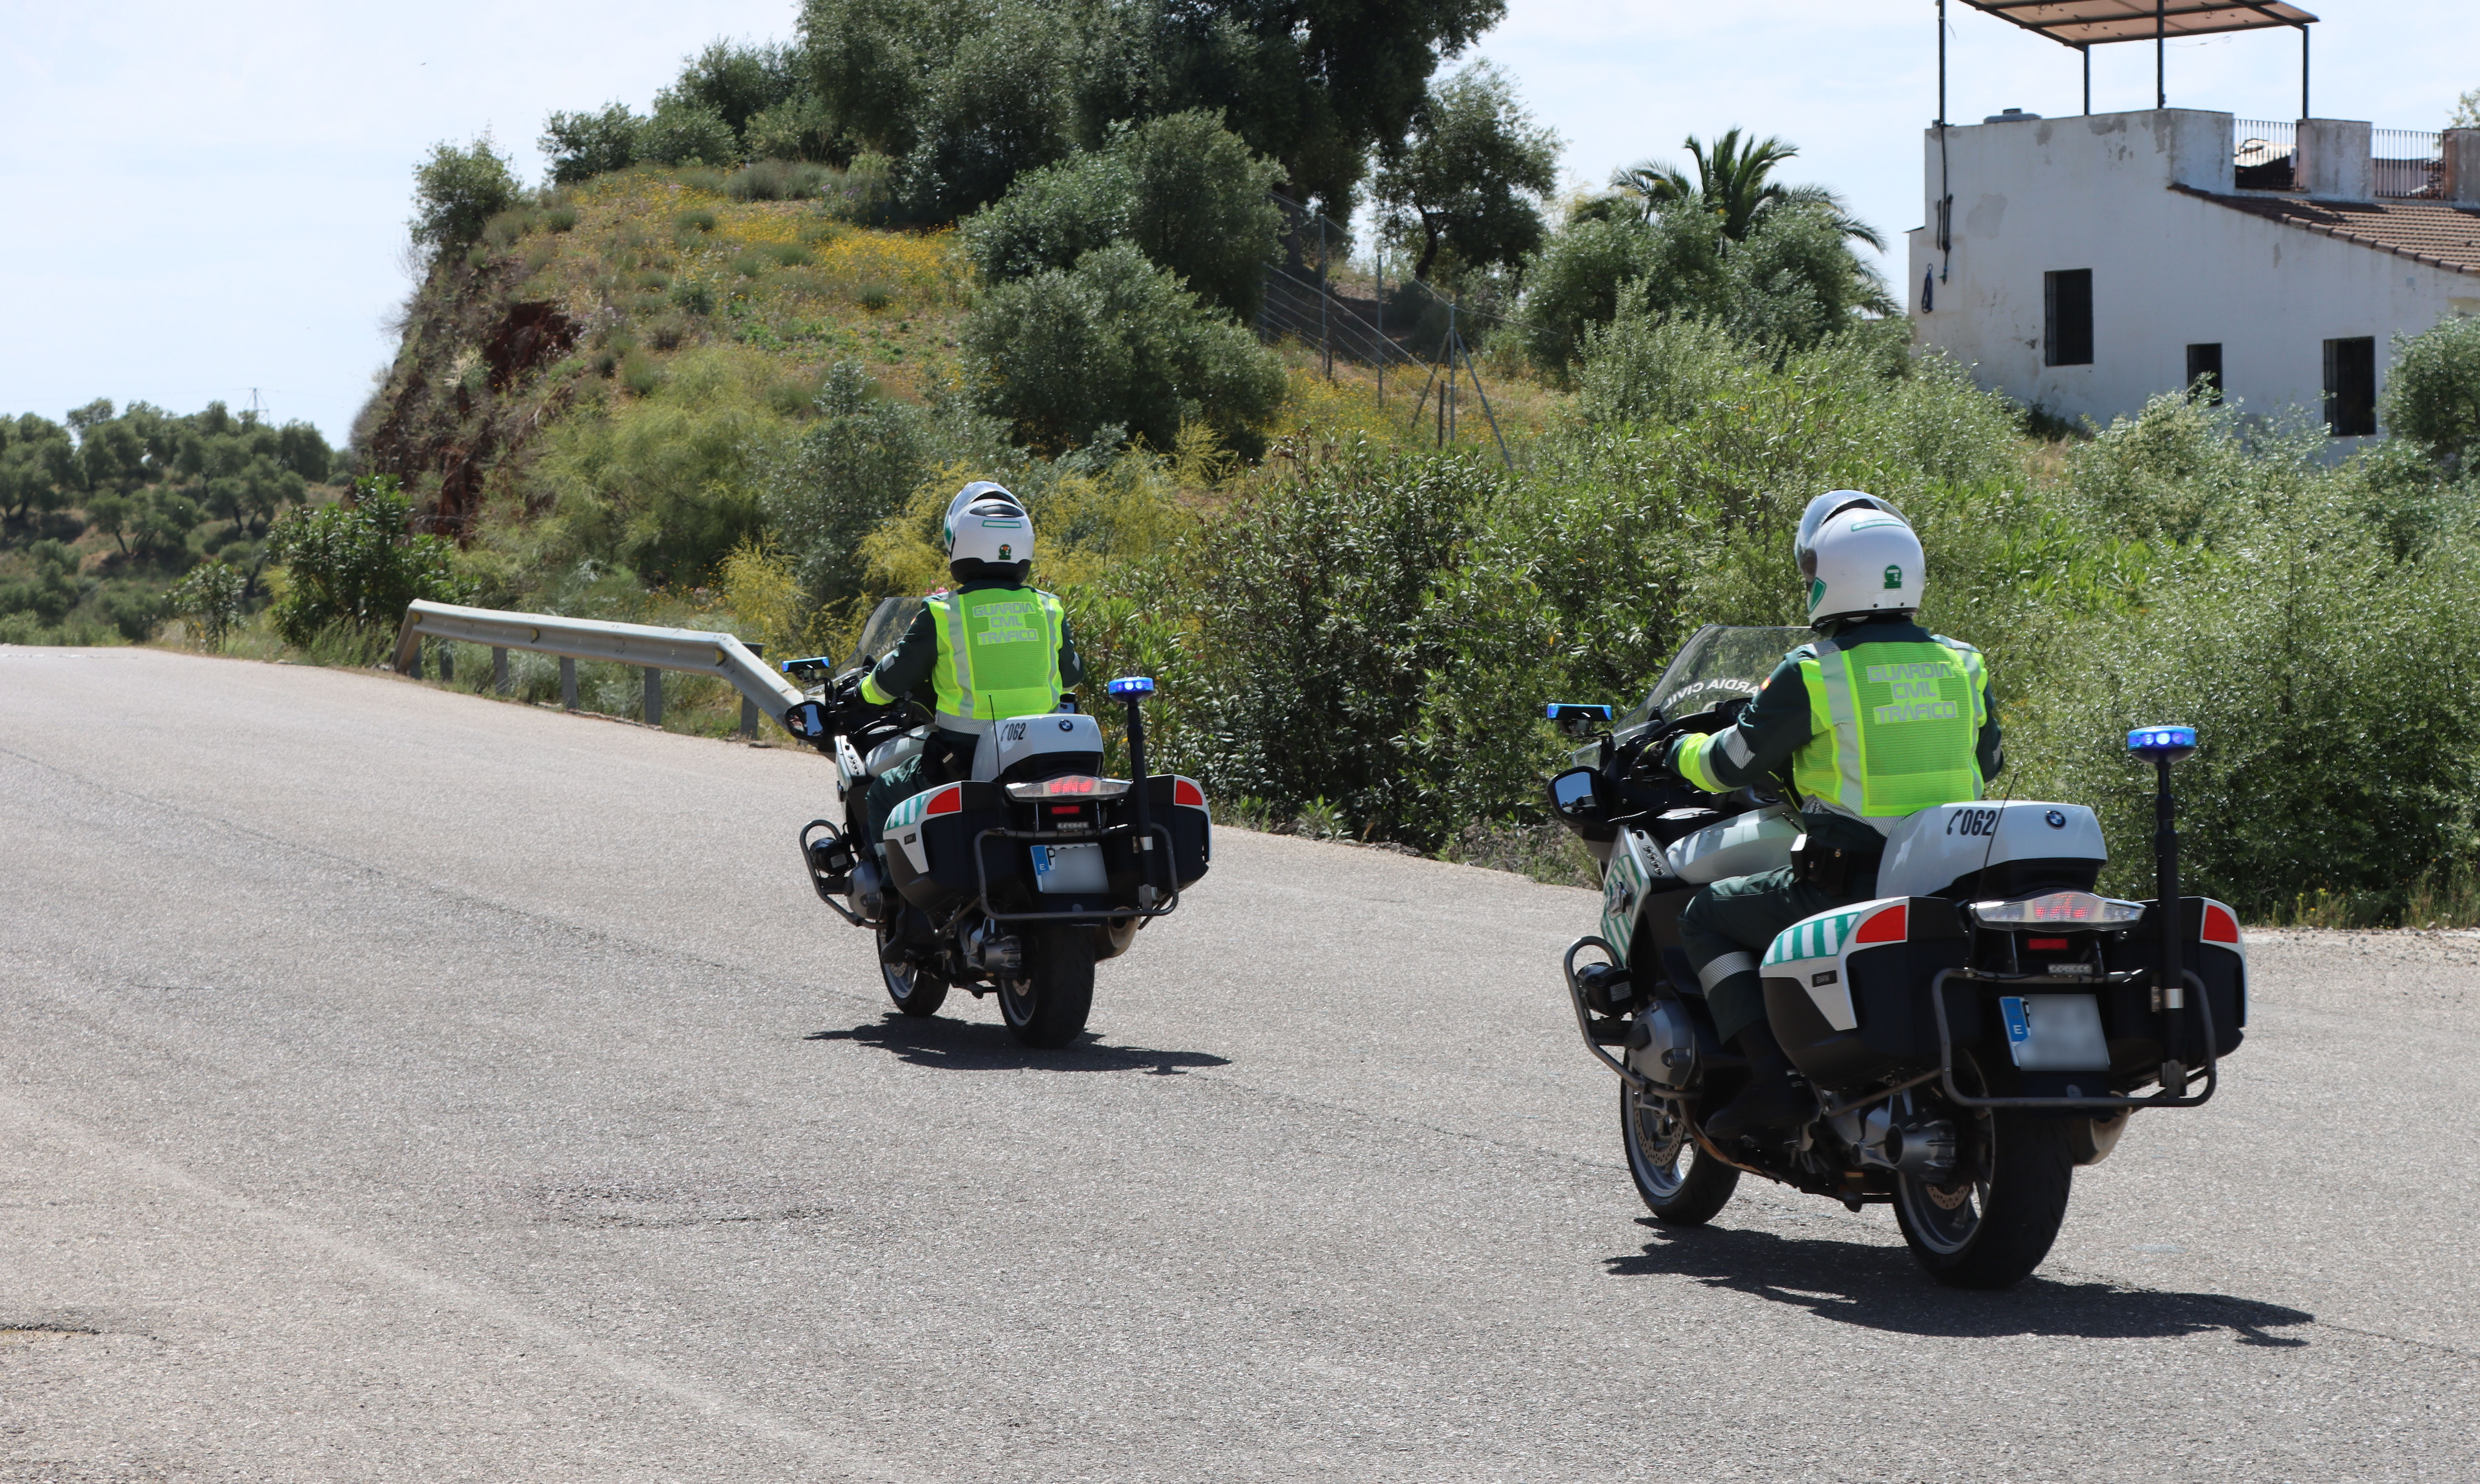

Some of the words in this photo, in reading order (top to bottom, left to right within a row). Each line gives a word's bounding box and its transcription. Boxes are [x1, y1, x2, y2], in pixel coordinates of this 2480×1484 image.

[974, 602, 1034, 616] GUARDIA
[990, 615, 1023, 628] CIVIL
[978, 629, 1037, 644] TRÁFICO
[1867, 663, 1953, 682] GUARDIA
[1892, 681, 1936, 699] CIVIL
[1876, 701, 1957, 723] TRÁFICO
[1007, 722, 1027, 741] 062
[1961, 809, 1996, 836] 062
[2013, 1025, 2023, 1034] E
